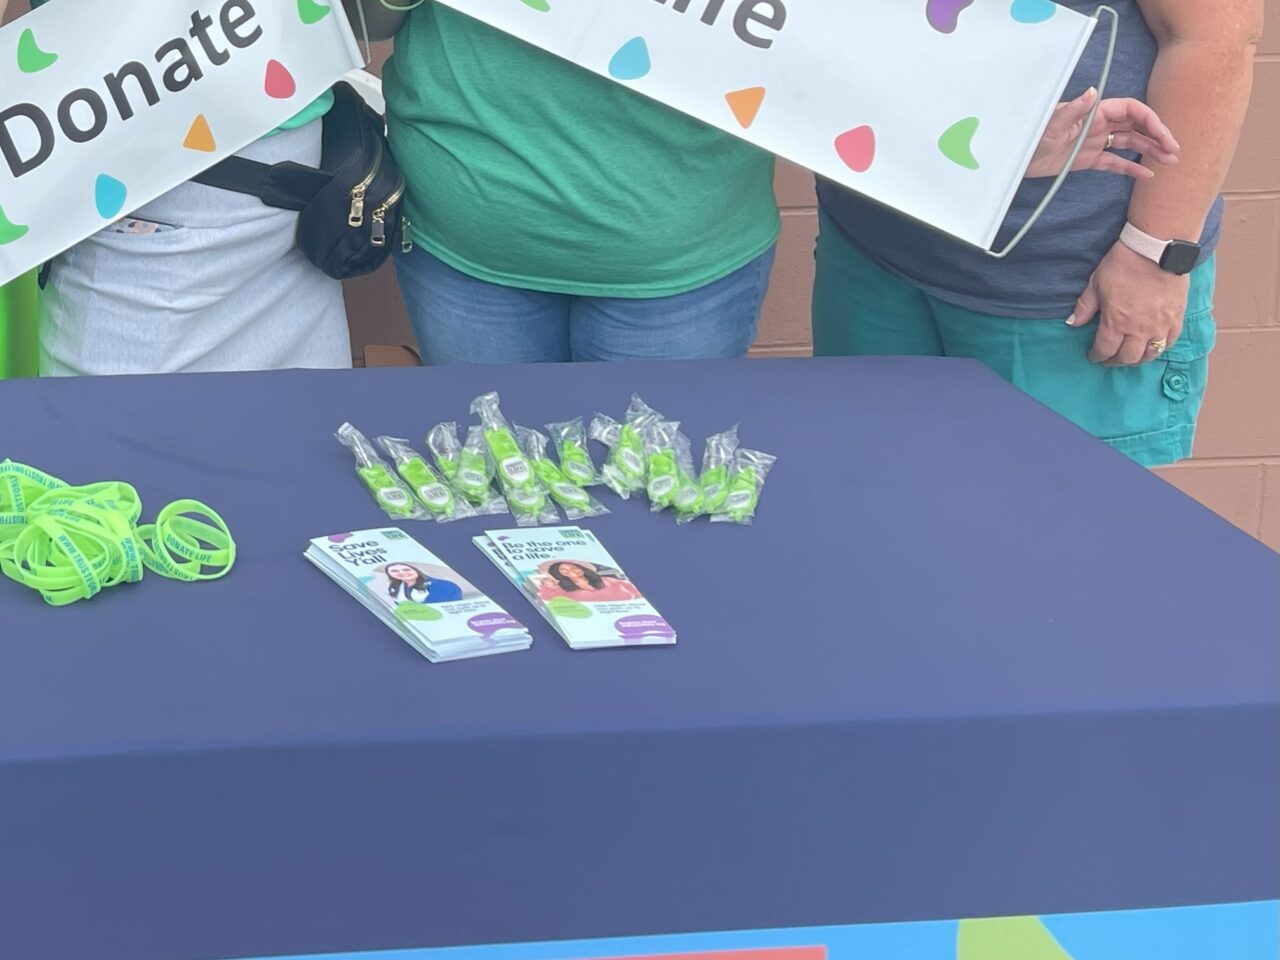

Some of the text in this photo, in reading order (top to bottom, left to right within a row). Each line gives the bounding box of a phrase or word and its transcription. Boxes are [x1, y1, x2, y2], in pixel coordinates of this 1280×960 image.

[328, 540, 380, 553] Save
[525, 540, 553, 548] the
[525, 545, 564, 553] save
[337, 547, 388, 560] Lives
[512, 553, 525, 561] a
[344, 555, 388, 567] Y'all
